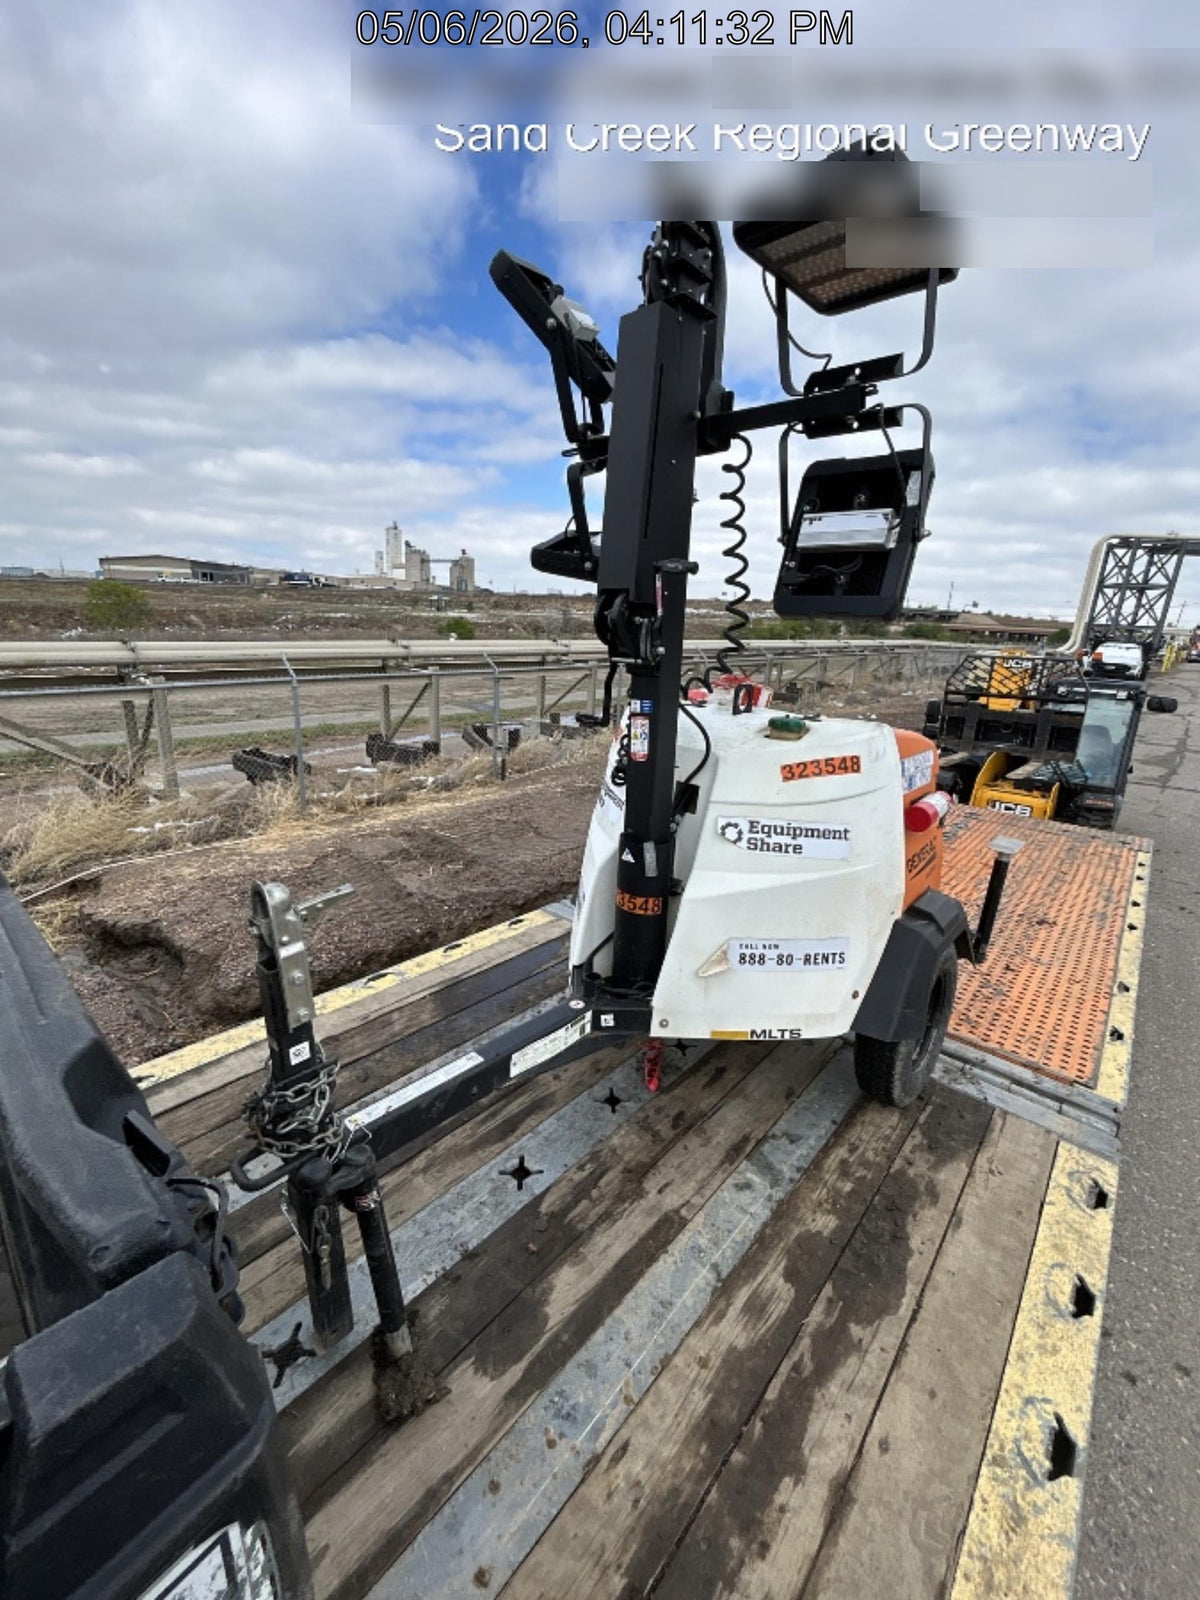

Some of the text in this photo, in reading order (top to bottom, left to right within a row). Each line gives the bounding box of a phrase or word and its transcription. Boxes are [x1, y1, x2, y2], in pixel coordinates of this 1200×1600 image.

[783, 755, 861, 781] 323548
[988, 801, 1033, 818] JCB
[747, 819, 851, 842] Equipment
[747, 837, 804, 855] Share
[738, 951, 846, 967] 888-80-RENTS
[749, 1028, 803, 1040] MLTS
